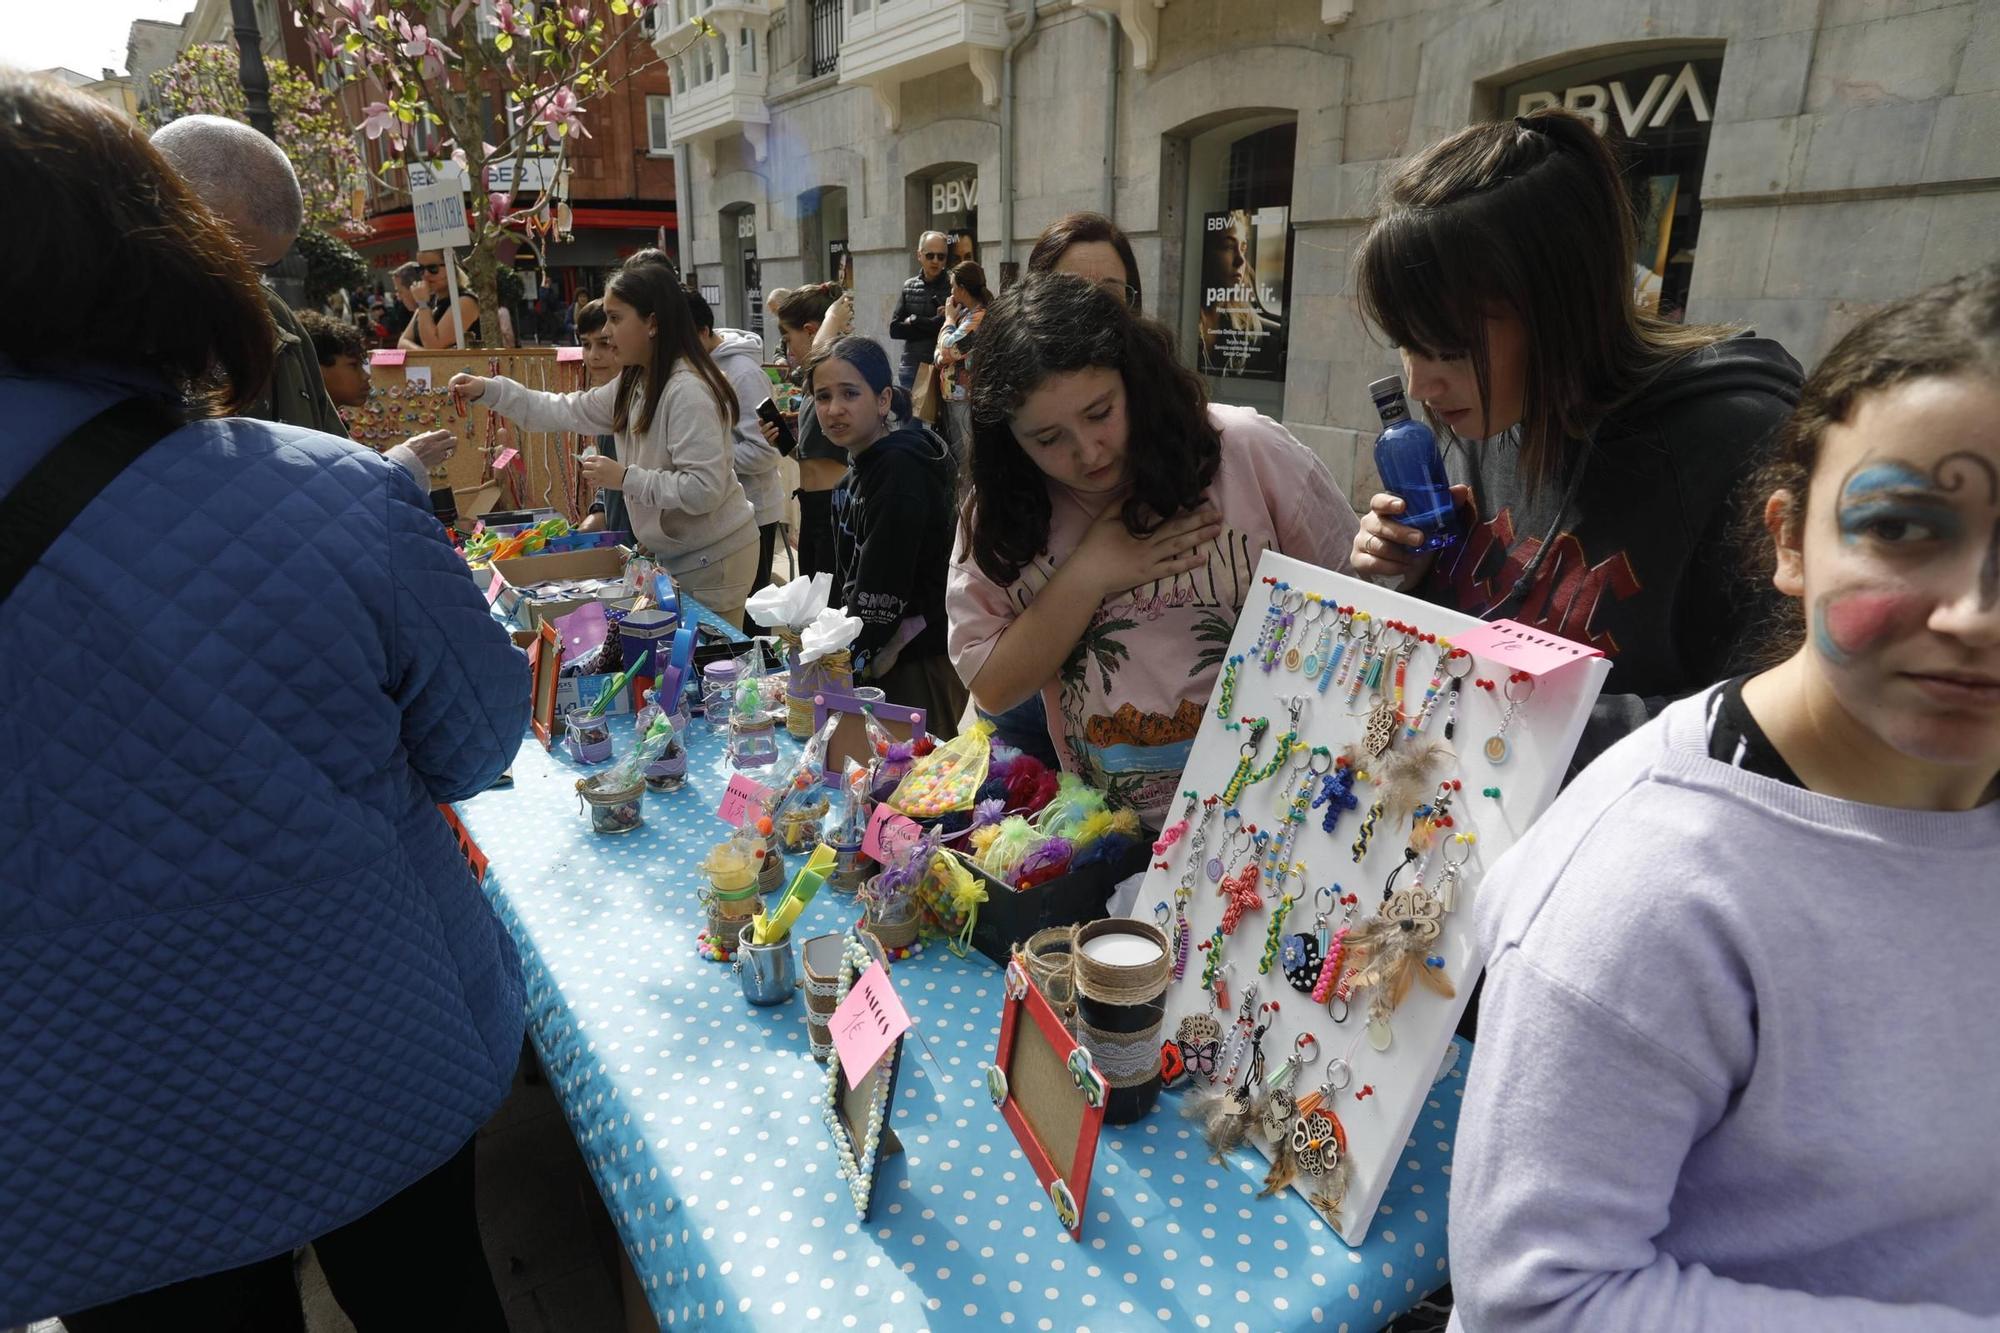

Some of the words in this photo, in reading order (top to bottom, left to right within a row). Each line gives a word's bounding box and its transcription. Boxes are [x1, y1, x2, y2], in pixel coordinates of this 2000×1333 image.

[737, 214, 756, 238] BB
[1207, 214, 1241, 231] BBVA
[1206, 282, 1256, 307] partir.
[1261, 282, 1276, 302] ir.
